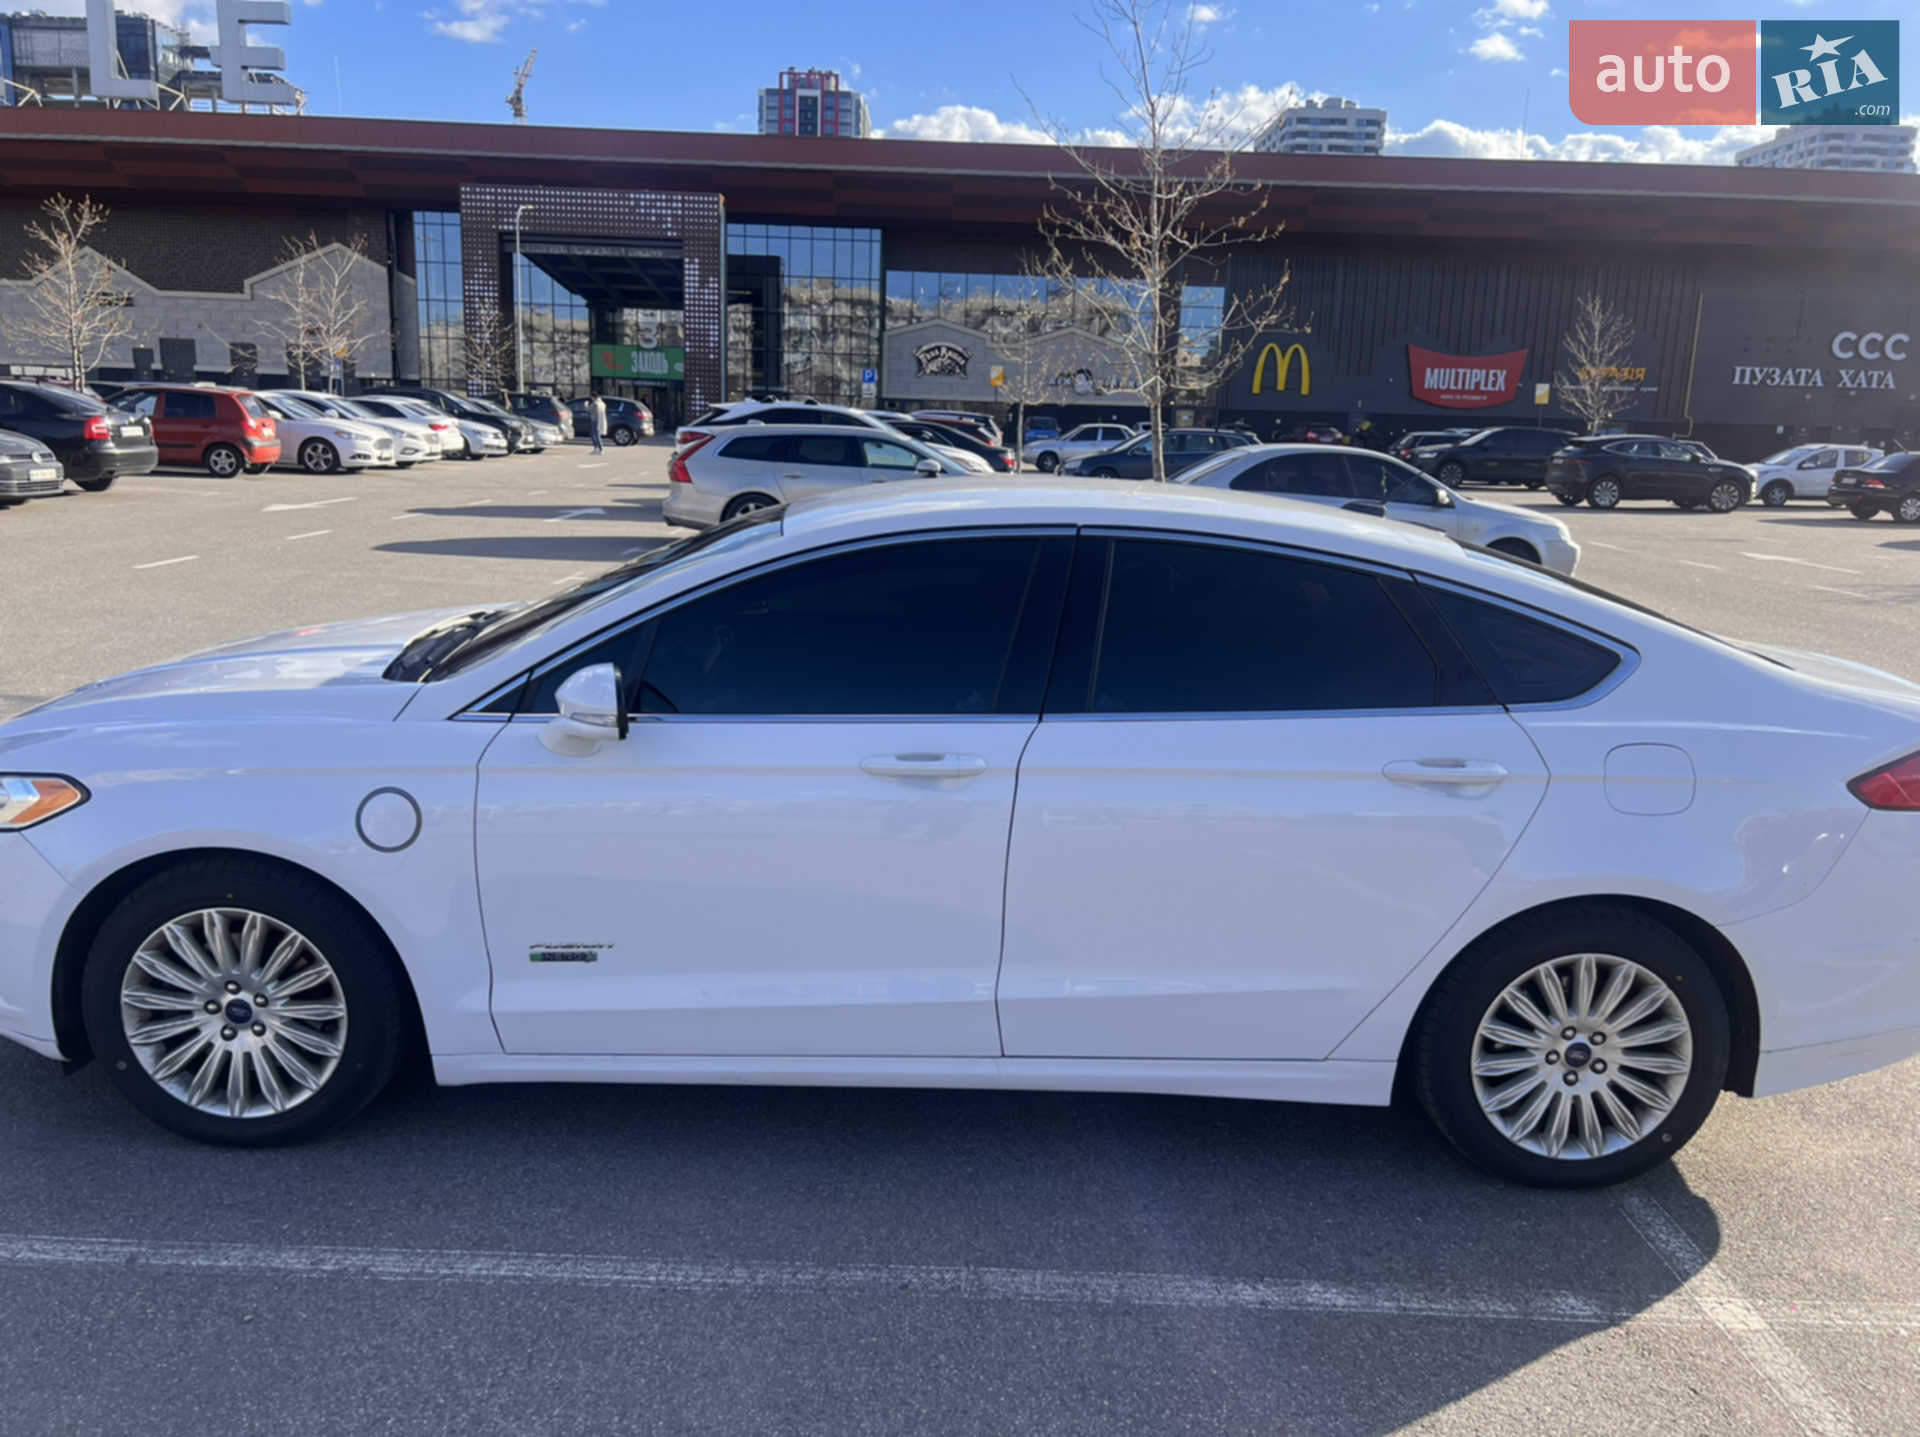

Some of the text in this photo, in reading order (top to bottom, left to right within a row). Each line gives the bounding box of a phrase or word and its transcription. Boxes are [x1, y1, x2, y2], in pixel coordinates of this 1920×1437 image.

[639, 323, 659, 350] 3
[1831, 331, 1911, 361] CCC
[864, 370, 874, 382] P
[1424, 367, 1508, 392] MULTIPLEX
[1732, 366, 1897, 390] ПУЗАТА ХАТА
